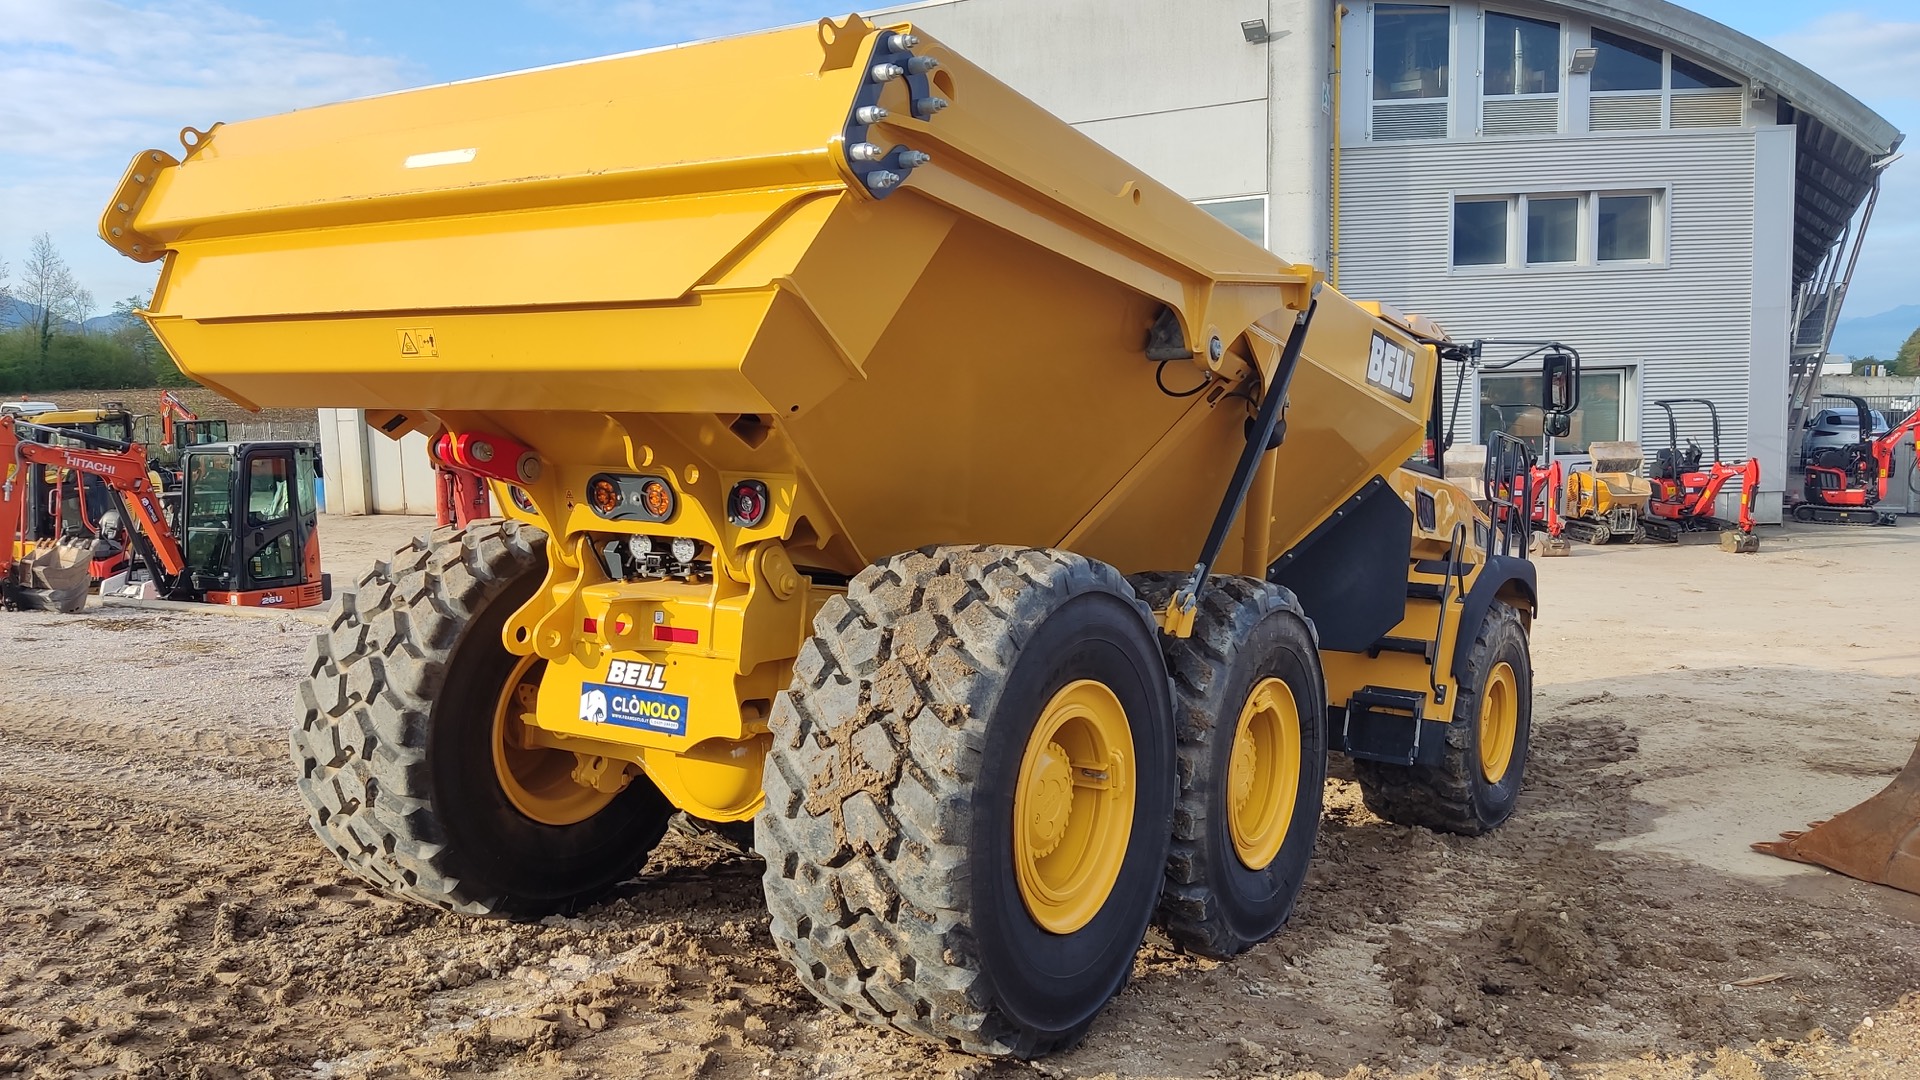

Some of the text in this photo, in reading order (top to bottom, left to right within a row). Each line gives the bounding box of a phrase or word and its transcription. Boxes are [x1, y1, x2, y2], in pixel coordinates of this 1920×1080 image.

[1366, 330, 1415, 401] BELL
[66, 456, 115, 475] HITACHI
[261, 595, 283, 605] 26U
[606, 659, 667, 691] BELL
[612, 694, 681, 721] CLÒNOLO
